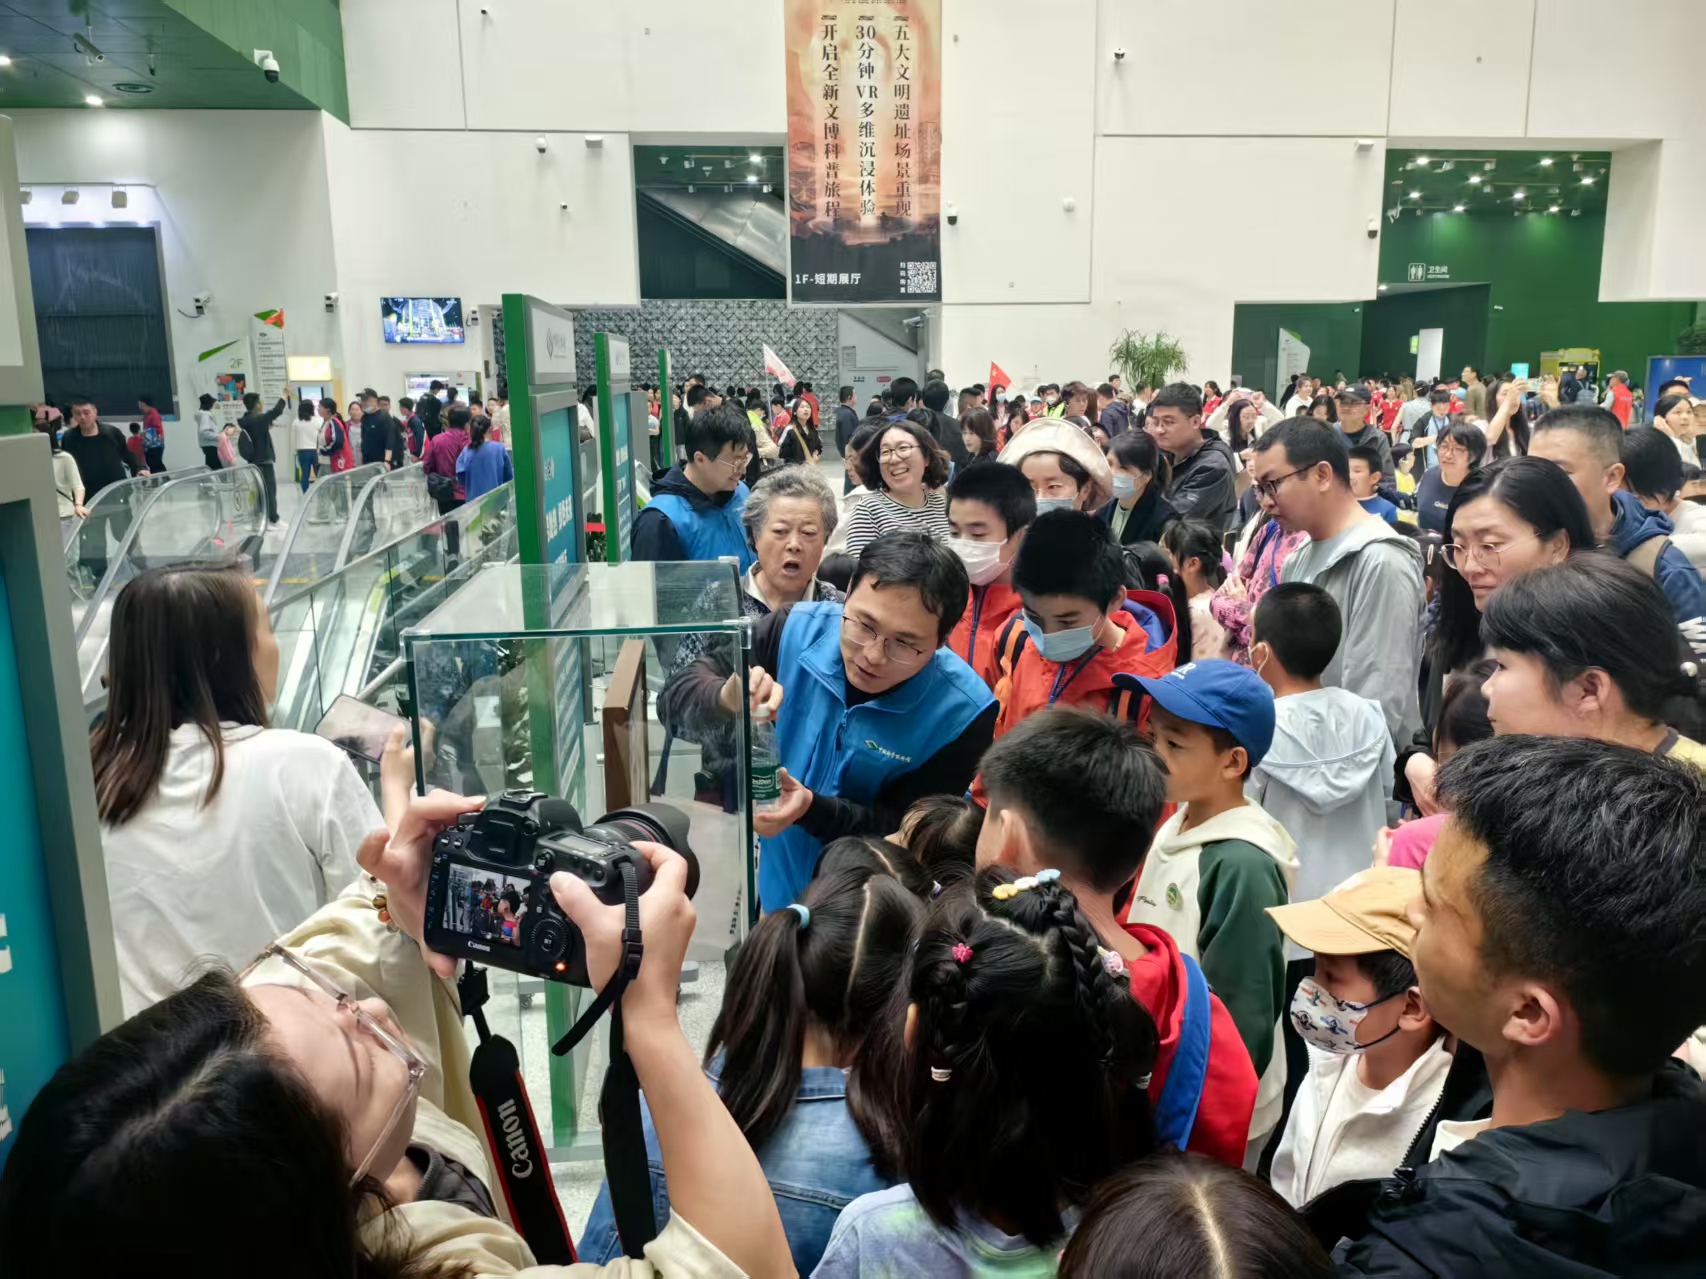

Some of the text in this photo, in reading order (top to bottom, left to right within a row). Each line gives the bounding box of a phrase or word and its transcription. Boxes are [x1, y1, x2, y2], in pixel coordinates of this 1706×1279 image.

[820, 24, 841, 218] 开启全新文博科普旅程
[894, 24, 912, 217] 五大文明遗址场景重现
[795, 272, 861, 285] 1F-短期展厅
[230, 358, 244, 369] 2F
[467, 940, 491, 952] Canon
[497, 1098, 533, 1179] Canon
